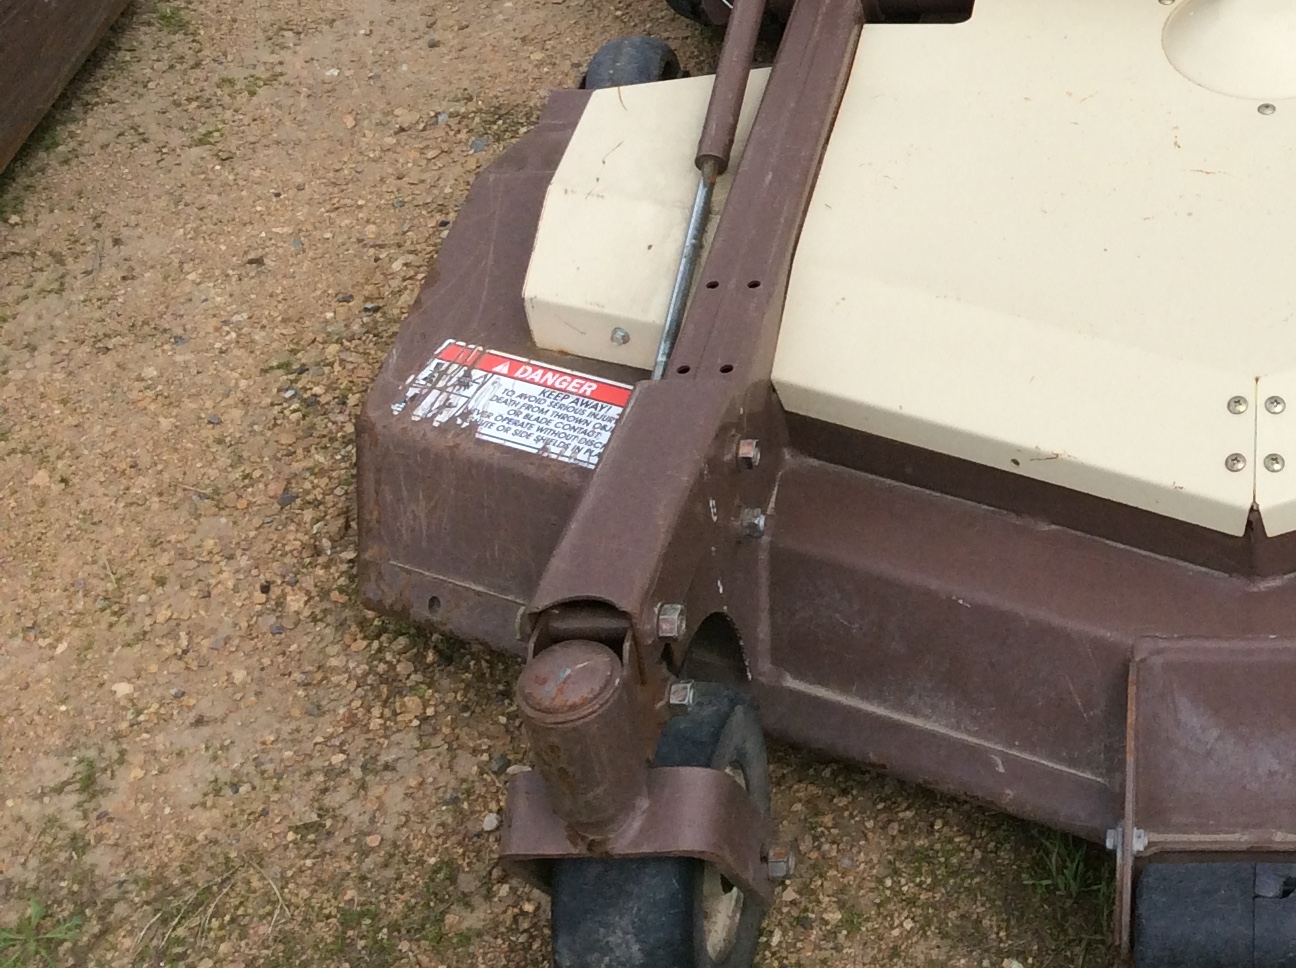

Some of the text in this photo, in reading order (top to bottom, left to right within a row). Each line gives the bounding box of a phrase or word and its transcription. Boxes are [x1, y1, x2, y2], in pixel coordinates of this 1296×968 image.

[514, 364, 598, 396] DANGER
[489, 393, 519, 407] DEATH
[519, 401, 549, 415] FROM
[550, 410, 592, 426] THROWN
[501, 387, 515, 397] TO
[517, 392, 547, 405] AVOID
[546, 400, 586, 416] SERIOUS
[538, 388, 612, 414] KEEP AWAY!
[493, 413, 534, 430] OPERATE
[534, 425, 577, 442] WITHOUT
[506, 407, 522, 417] OR
[522, 412, 553, 425] BLADE
[495, 423, 511, 433] OR
[511, 428, 534, 439] SIDE
